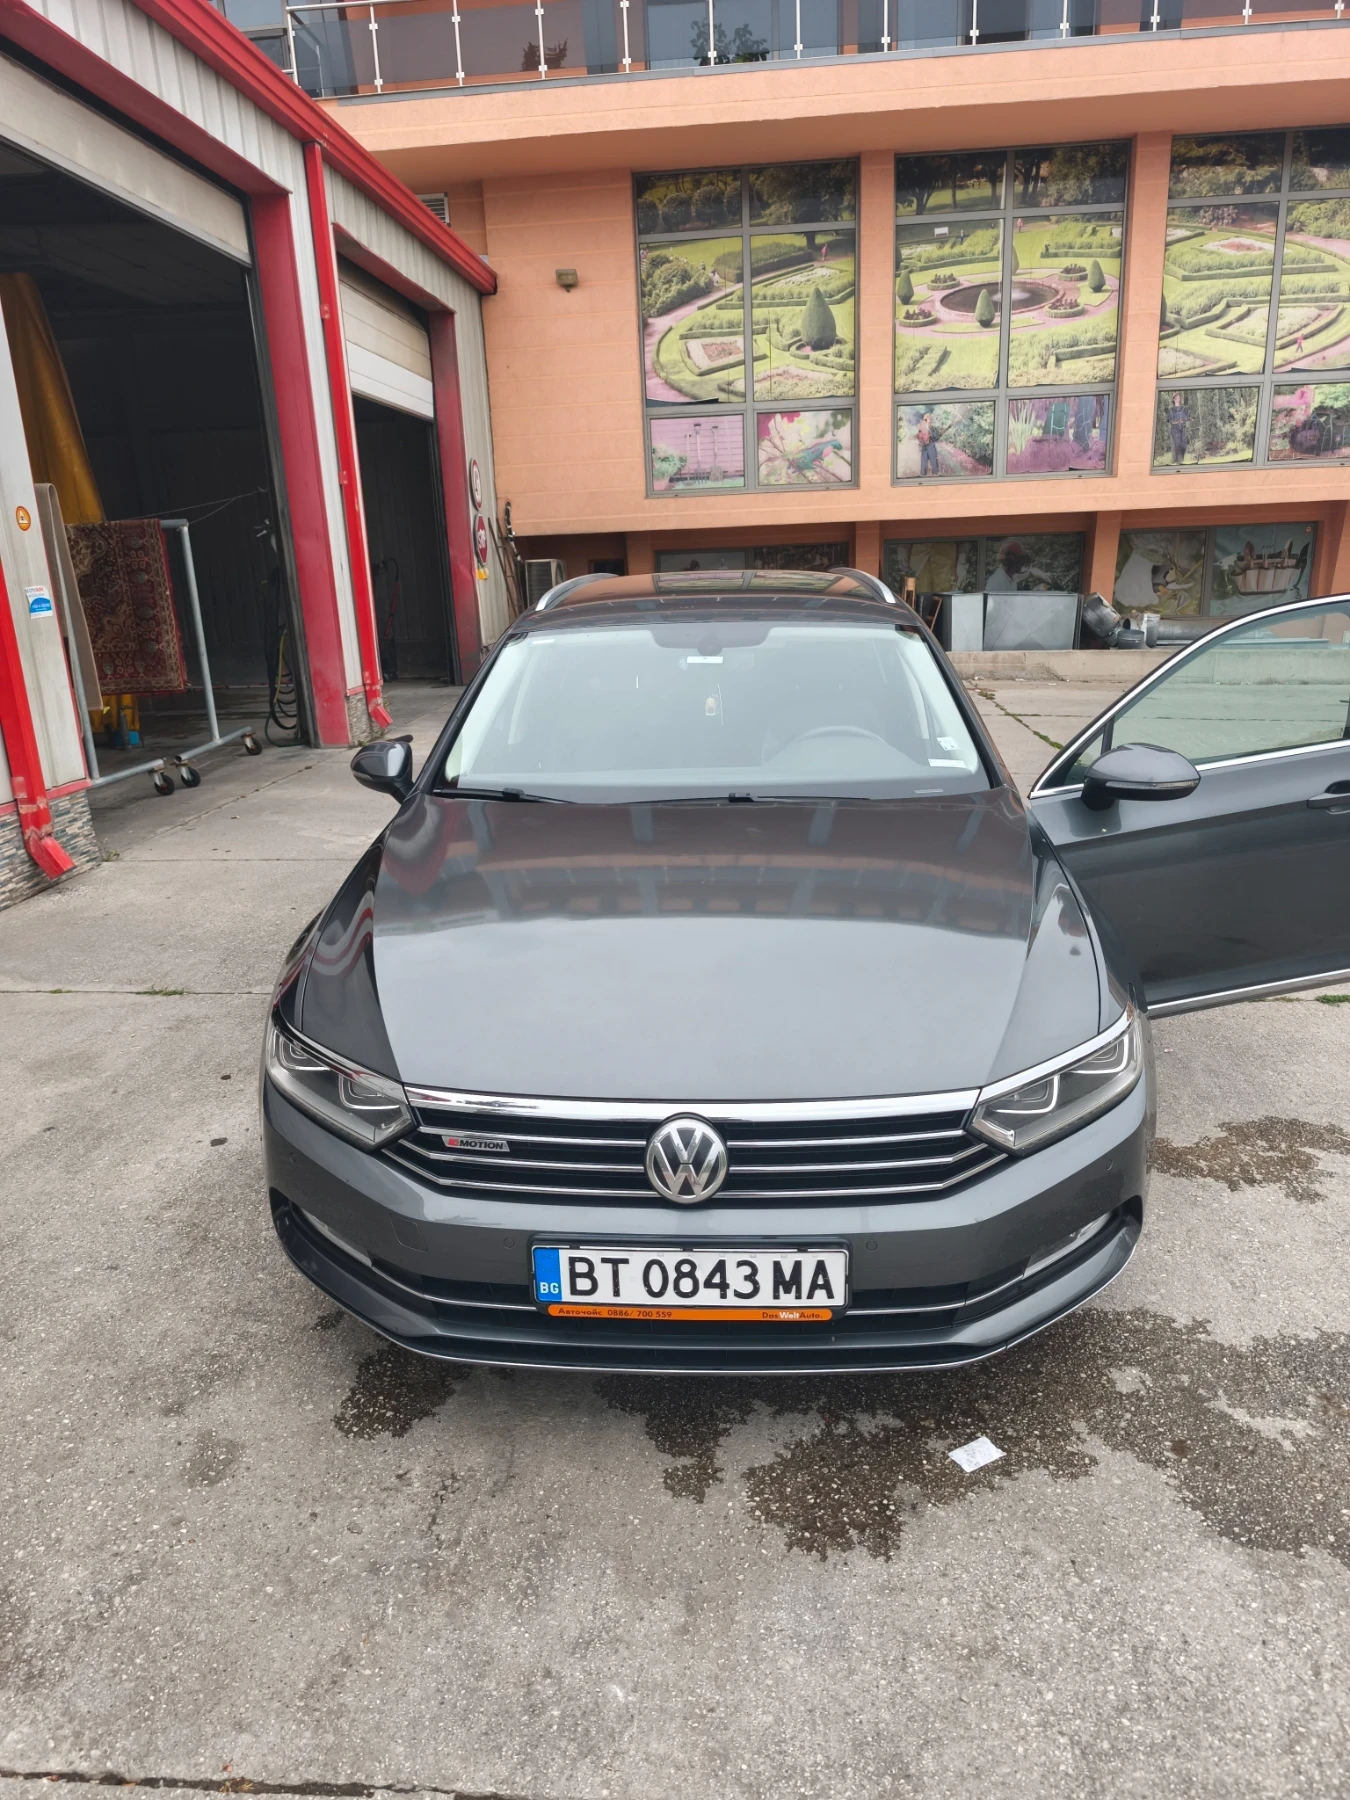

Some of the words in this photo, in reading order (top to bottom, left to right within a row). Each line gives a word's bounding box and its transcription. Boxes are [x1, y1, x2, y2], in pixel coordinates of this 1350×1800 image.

[568, 1255, 630, 1298] BT
[642, 1257, 761, 1300] 0843
[772, 1259, 835, 1300] MA
[539, 1281, 560, 1295] BG
[637, 1310, 653, 1318] 700
